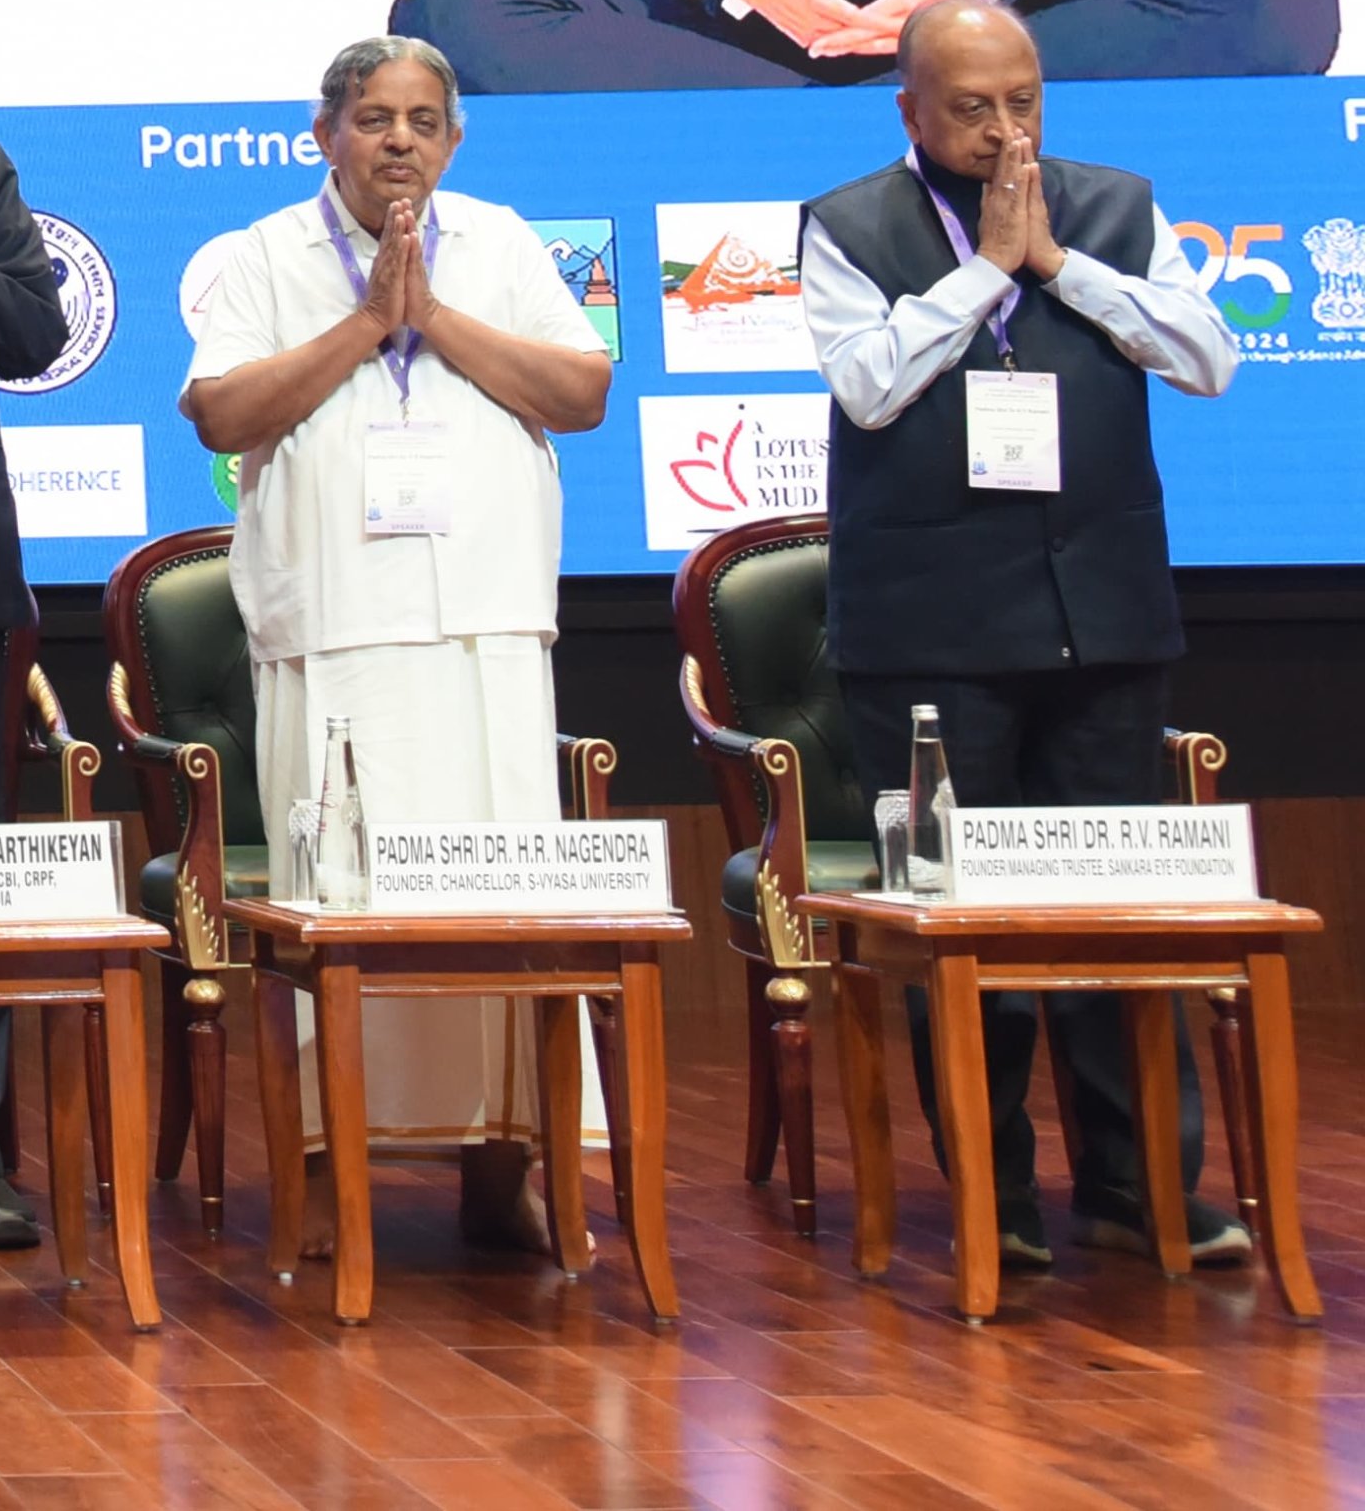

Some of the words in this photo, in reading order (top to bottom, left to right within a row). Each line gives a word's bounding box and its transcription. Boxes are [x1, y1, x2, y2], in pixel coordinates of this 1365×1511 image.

[759, 486, 817, 507] MUD
[964, 820, 1028, 849] PADMA
[1034, 820, 1077, 849] SHRI
[1084, 820, 1114, 849] DR.
[1121, 820, 1152, 849] R.V.
[1158, 819, 1231, 849] RAMANI
[377, 835, 435, 864] PADMA
[440, 835, 479, 864] SHRI
[485, 835, 512, 864] DR.
[518, 835, 550, 864] H.R.
[555, 834, 650, 863] NAGENDRA
[376, 874, 437, 892] FOUNDER,
[528, 873, 577, 889] S-VYASA
[581, 873, 650, 889] UNIVERSITY
